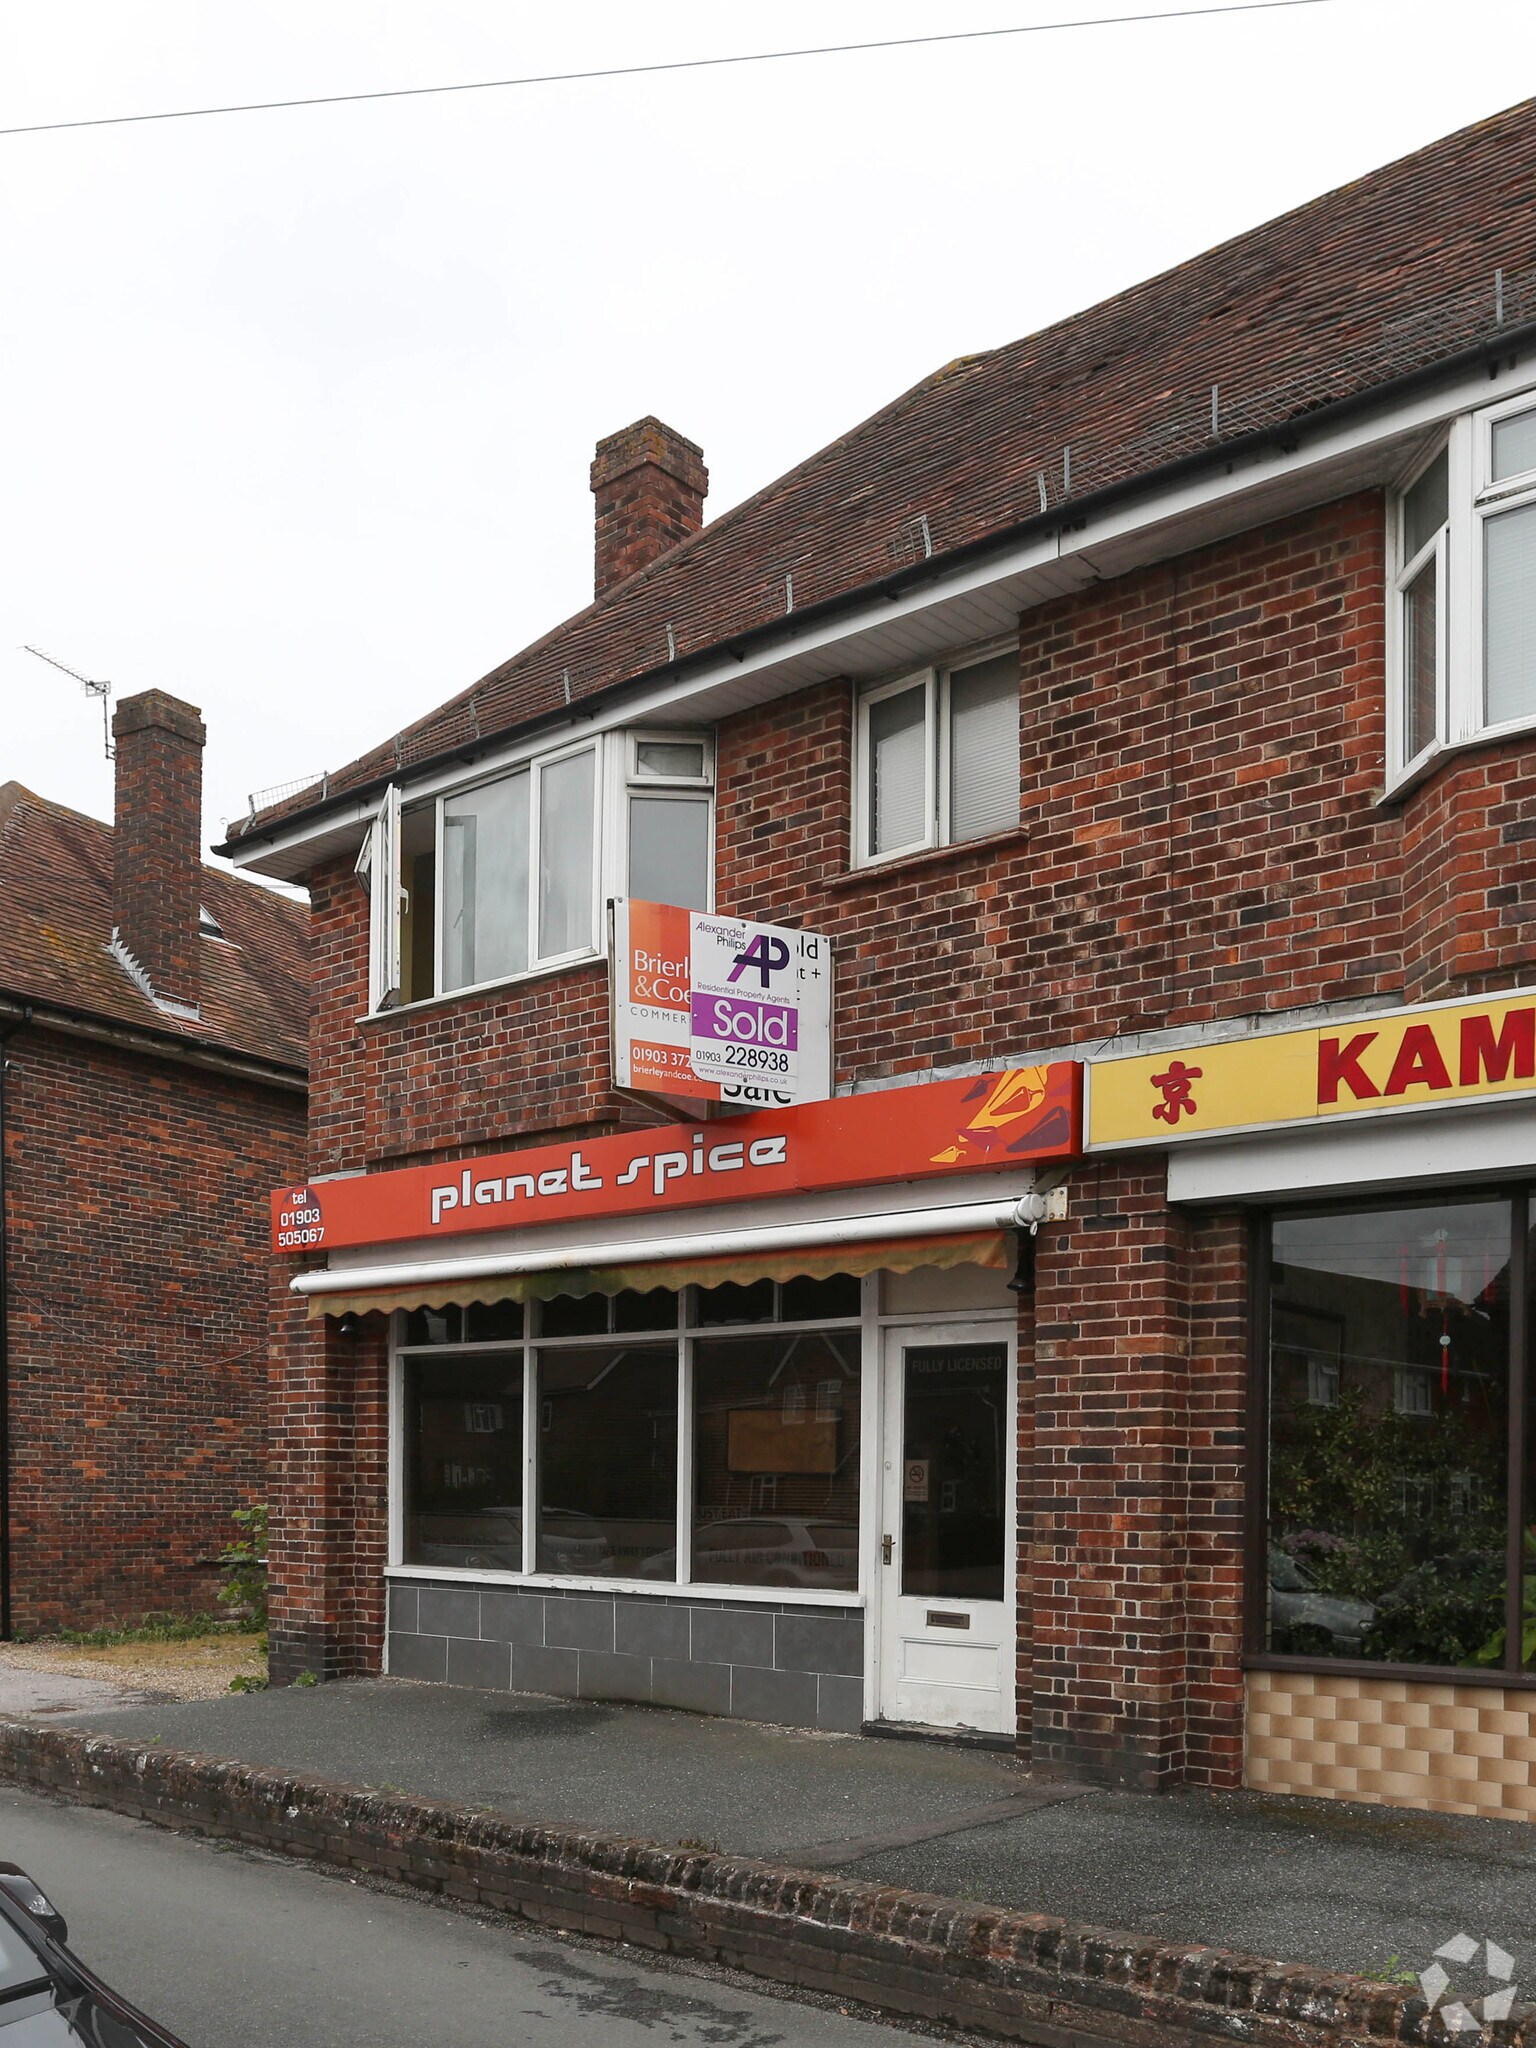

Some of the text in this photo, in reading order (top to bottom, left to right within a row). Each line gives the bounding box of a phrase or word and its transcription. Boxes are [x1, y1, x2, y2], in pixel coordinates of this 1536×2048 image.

[695, 921, 746, 940] Alexander
[716, 935, 747, 951] Philips
[634, 949, 691, 979] Brierl
[697, 982, 736, 996] Residential
[736, 988, 766, 1001] Property
[766, 994, 790, 1005] Agents
[713, 999, 788, 1046] Sold
[632, 1046, 668, 1065] 01903
[695, 1045, 789, 1072] 01903 228938
[1316, 1007, 1535, 1105] KAM
[698, 1066, 788, 1085] www.alexanderphilips.co.uk
[1150, 1060, 1203, 1125] 京
[430, 1131, 788, 1225] planet spice
[292, 1189, 307, 1205] tel
[280, 1208, 320, 1227] 01903
[278, 1227, 325, 1247] 505067
